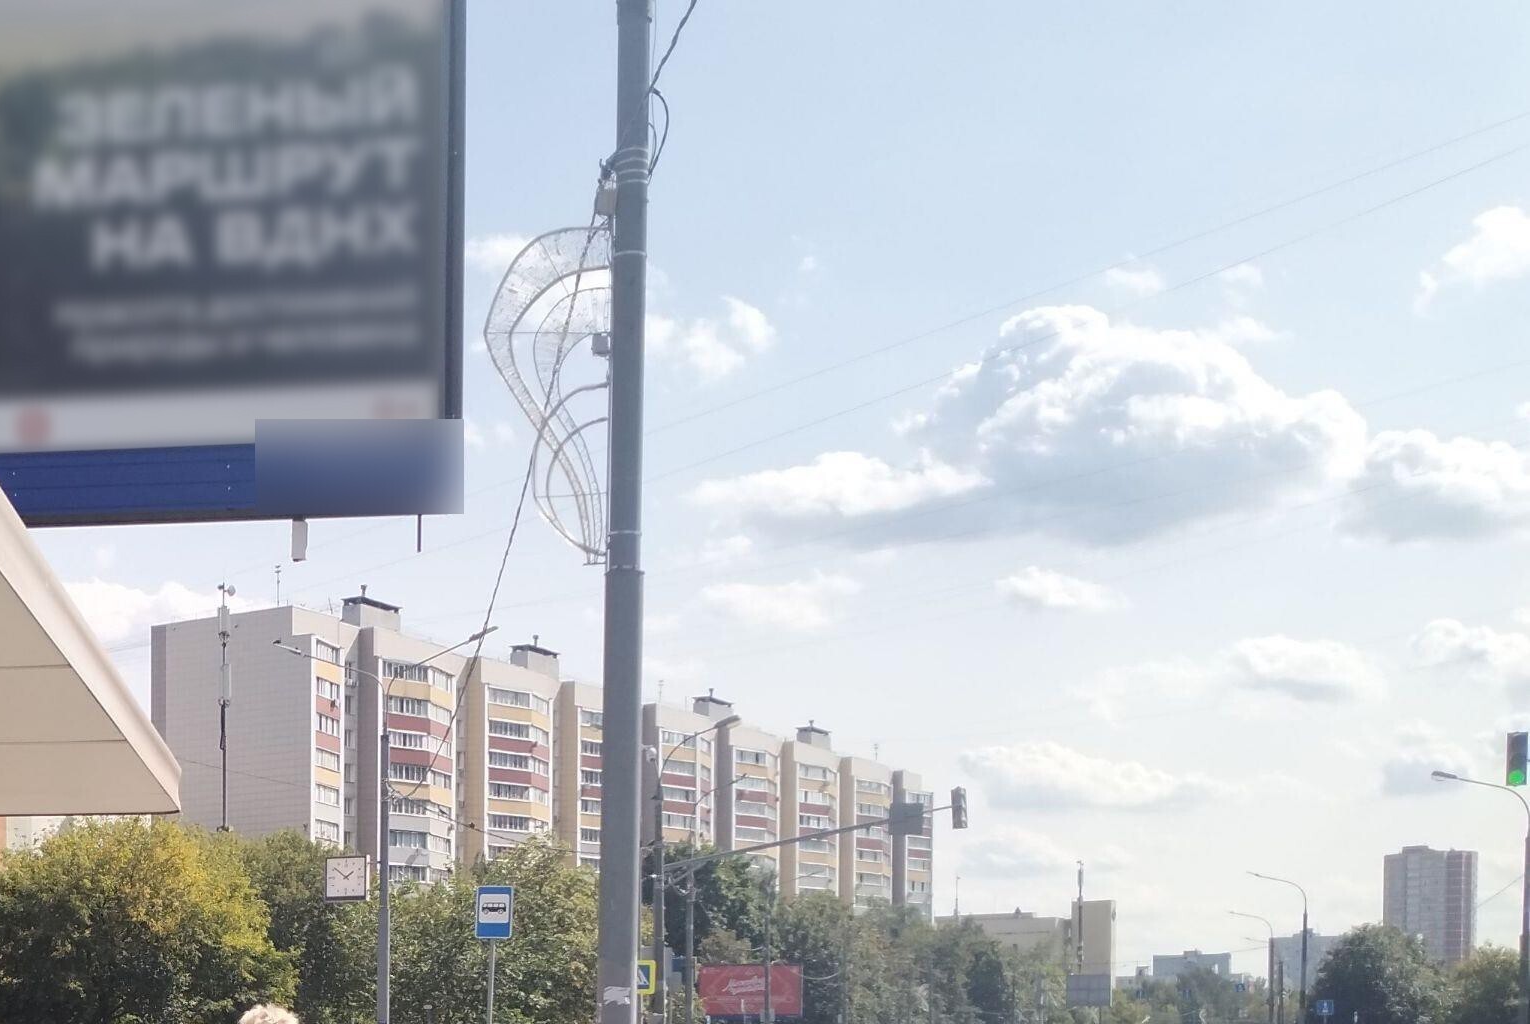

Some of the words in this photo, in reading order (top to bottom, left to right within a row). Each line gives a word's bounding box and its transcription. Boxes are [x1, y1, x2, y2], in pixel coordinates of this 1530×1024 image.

[35, 139, 419, 207] МАРШРУТ
[90, 212, 192, 272] НА
[218, 204, 418, 270] ВДНХ
